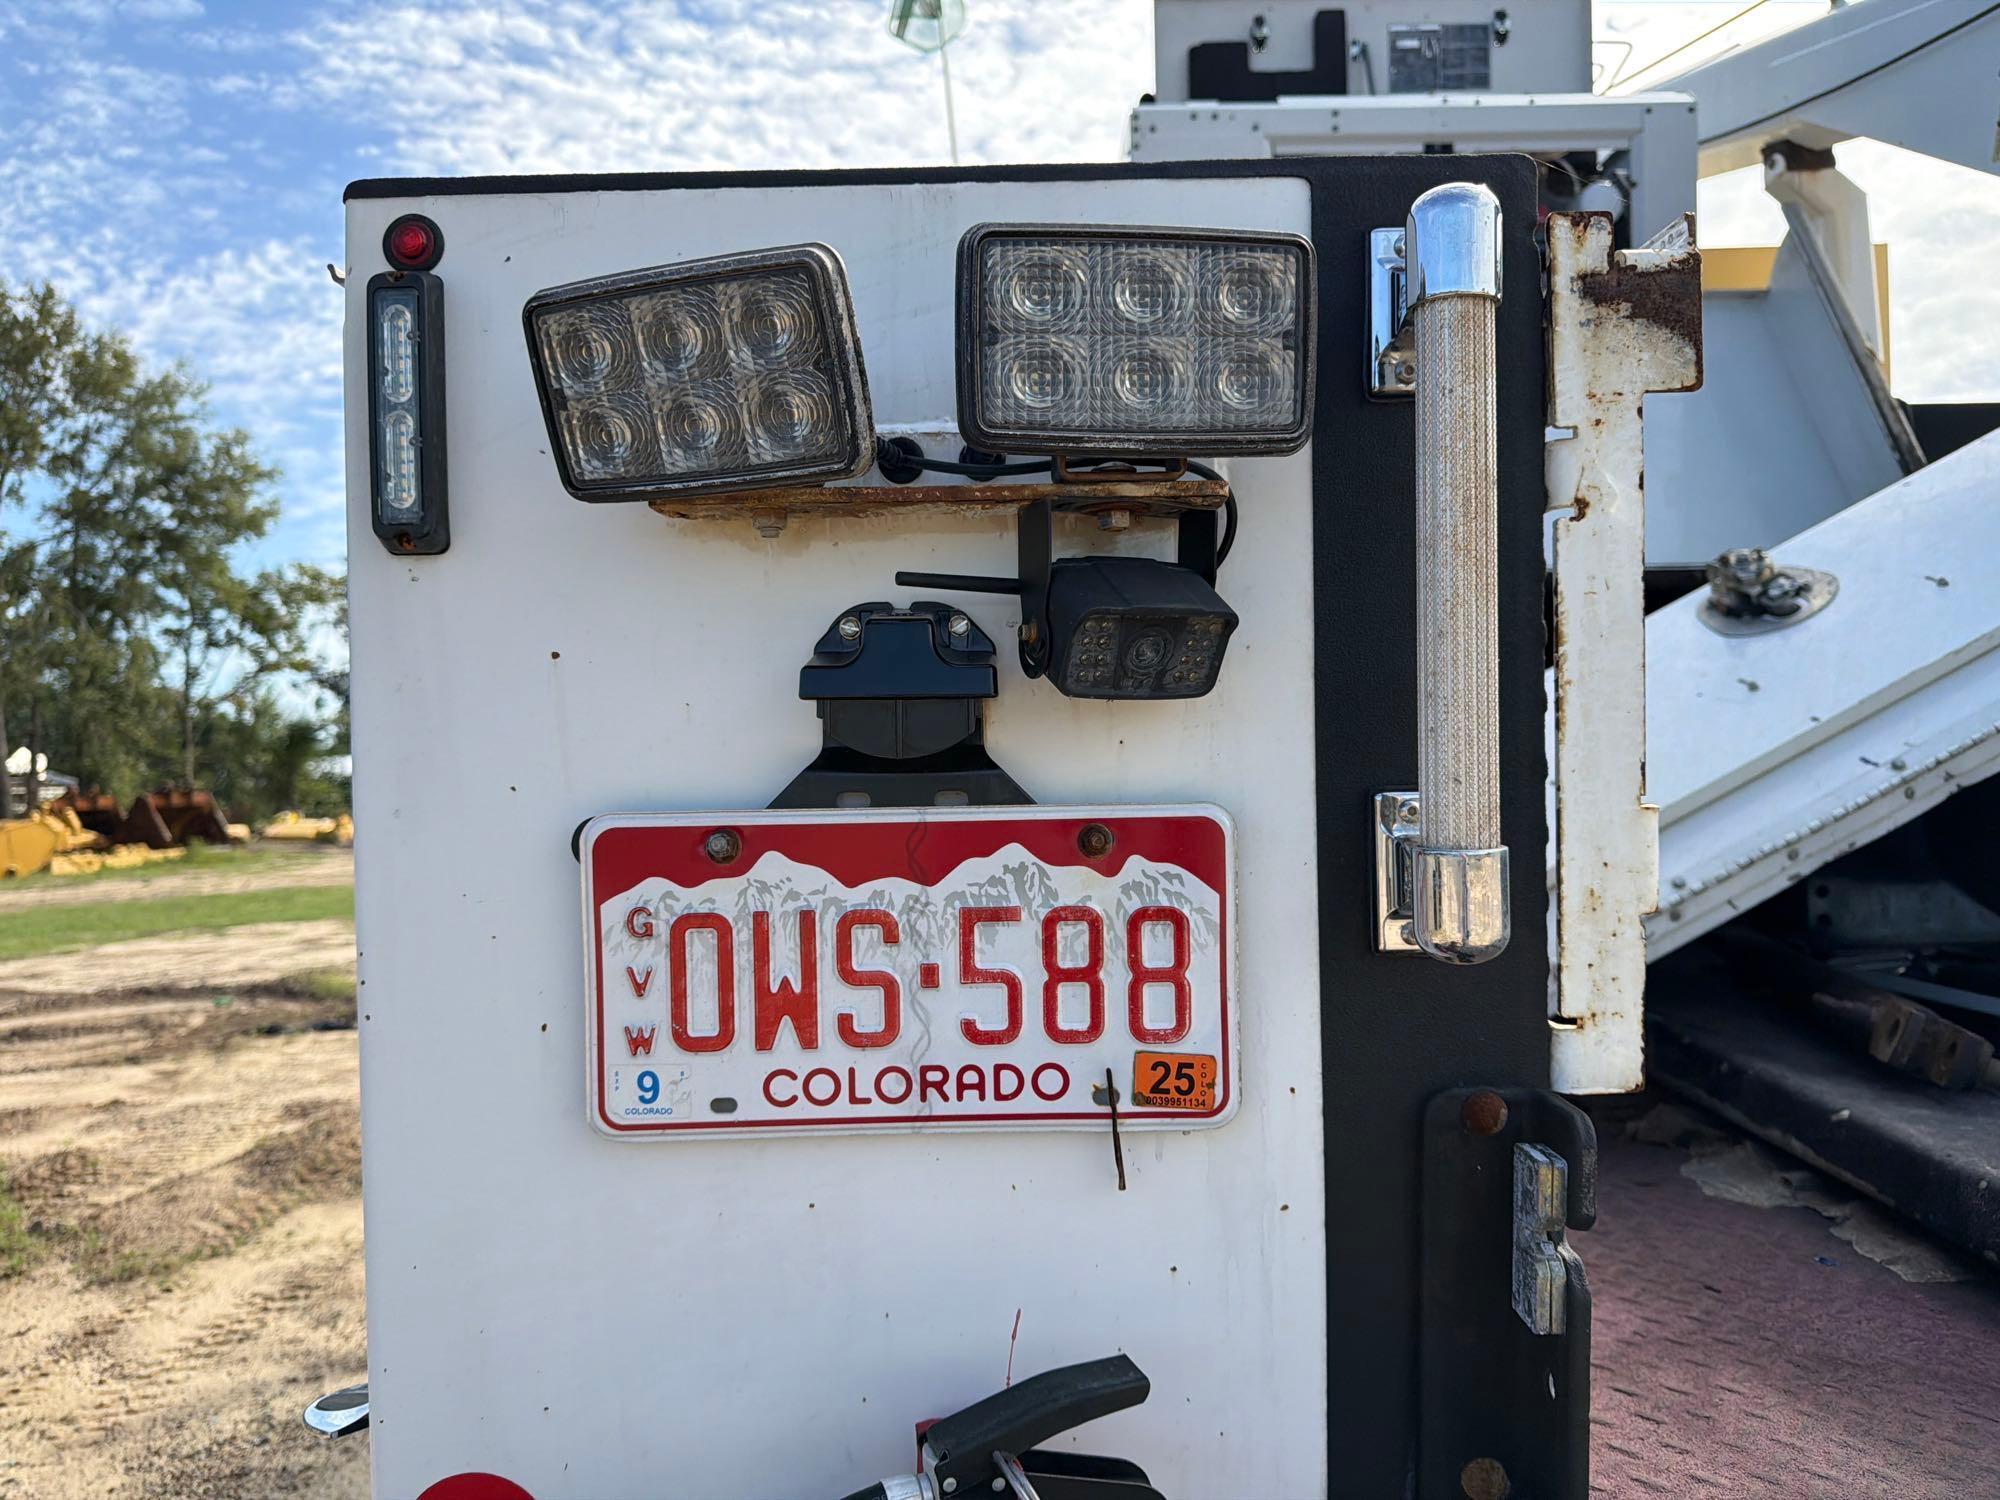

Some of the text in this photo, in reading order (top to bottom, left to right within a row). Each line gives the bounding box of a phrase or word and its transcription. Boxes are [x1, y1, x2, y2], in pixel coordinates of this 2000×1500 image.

[624, 906, 656, 1056] GVW
[636, 1070, 660, 1105] 9
[762, 1062, 1070, 1108] COLORADO
[1149, 1061, 1195, 1096] 25
[624, 1107, 673, 1115] COLORADO
